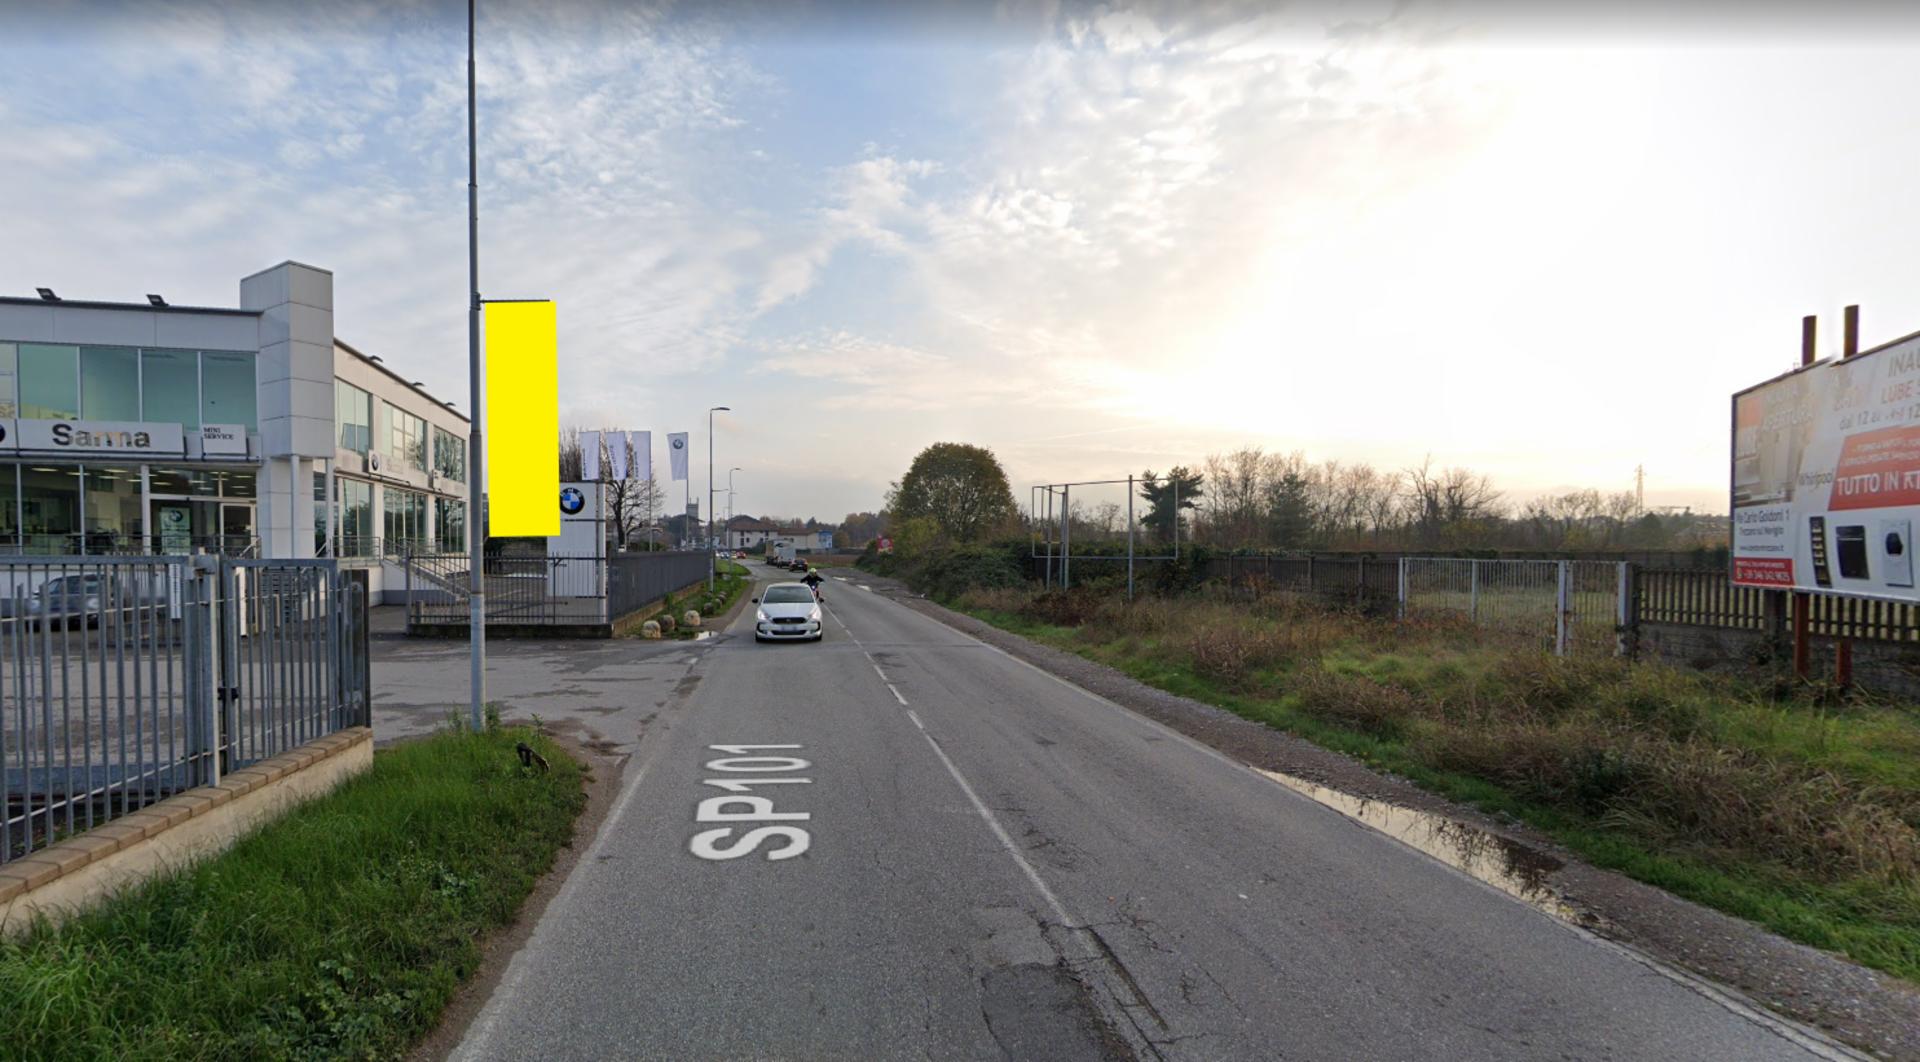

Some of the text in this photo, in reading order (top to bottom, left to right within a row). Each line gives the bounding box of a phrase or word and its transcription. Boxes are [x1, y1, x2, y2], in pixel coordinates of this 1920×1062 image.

[1837, 473, 1880, 496] TUTTO
[1884, 470, 1899, 491] IN
[690, 744, 812, 861] SP101
